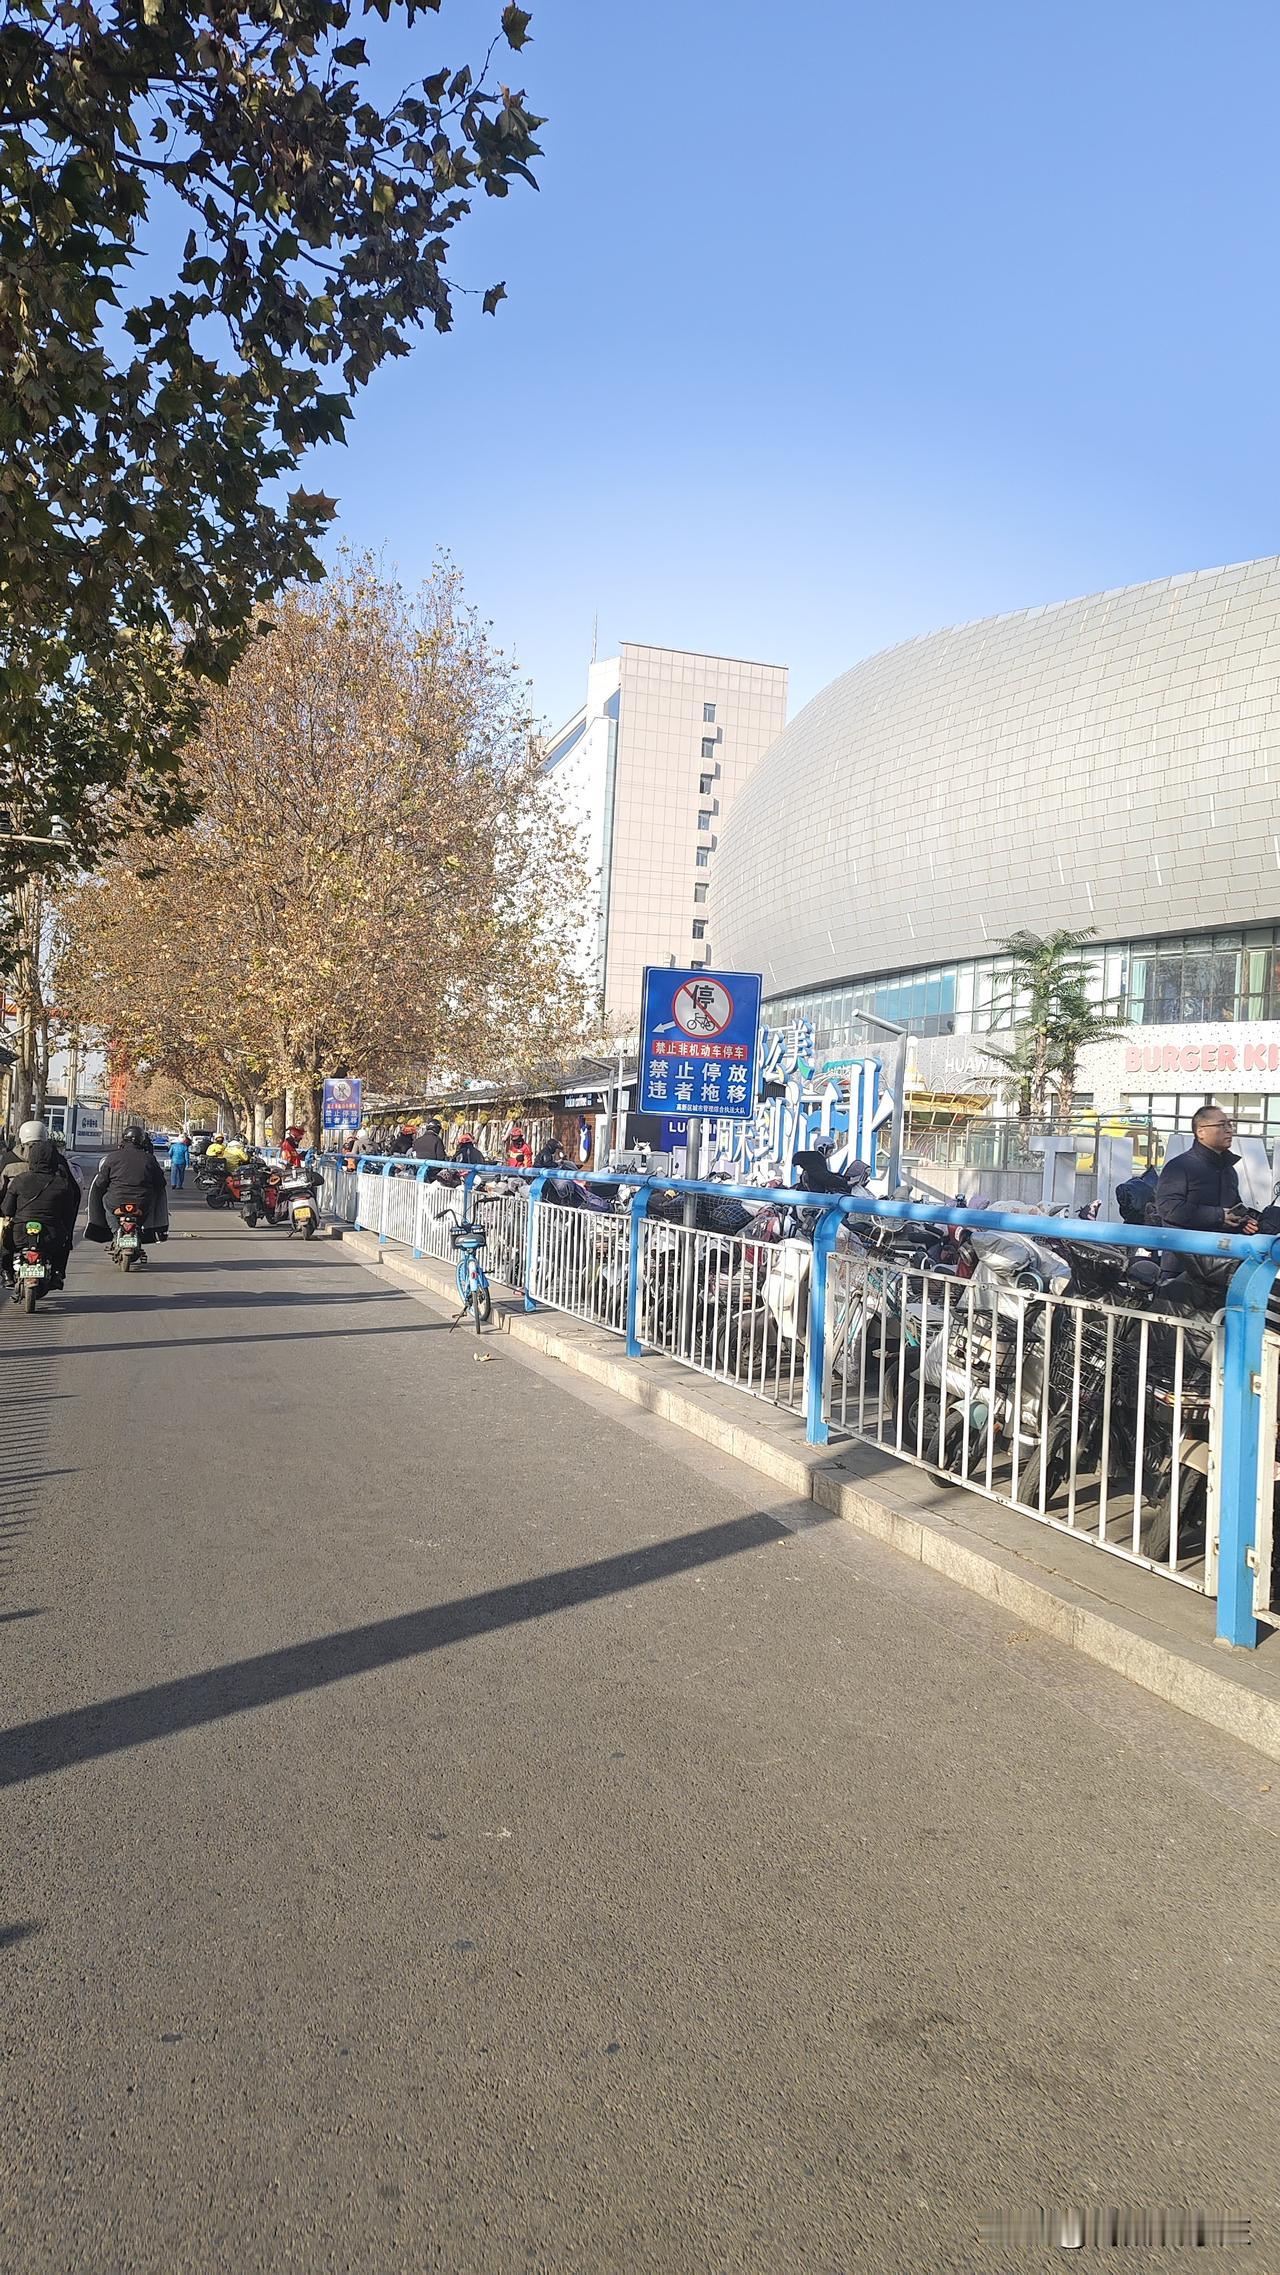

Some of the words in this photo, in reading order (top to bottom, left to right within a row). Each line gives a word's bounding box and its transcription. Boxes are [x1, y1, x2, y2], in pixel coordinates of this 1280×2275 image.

[692, 985, 715, 1009] 停
[655, 1042, 744, 1059] 禁止非机动车停车
[1125, 1043, 1238, 1073] BURGER
[649, 1060, 748, 1083] 禁止停放
[647, 1080, 747, 1104] 违者拖移
